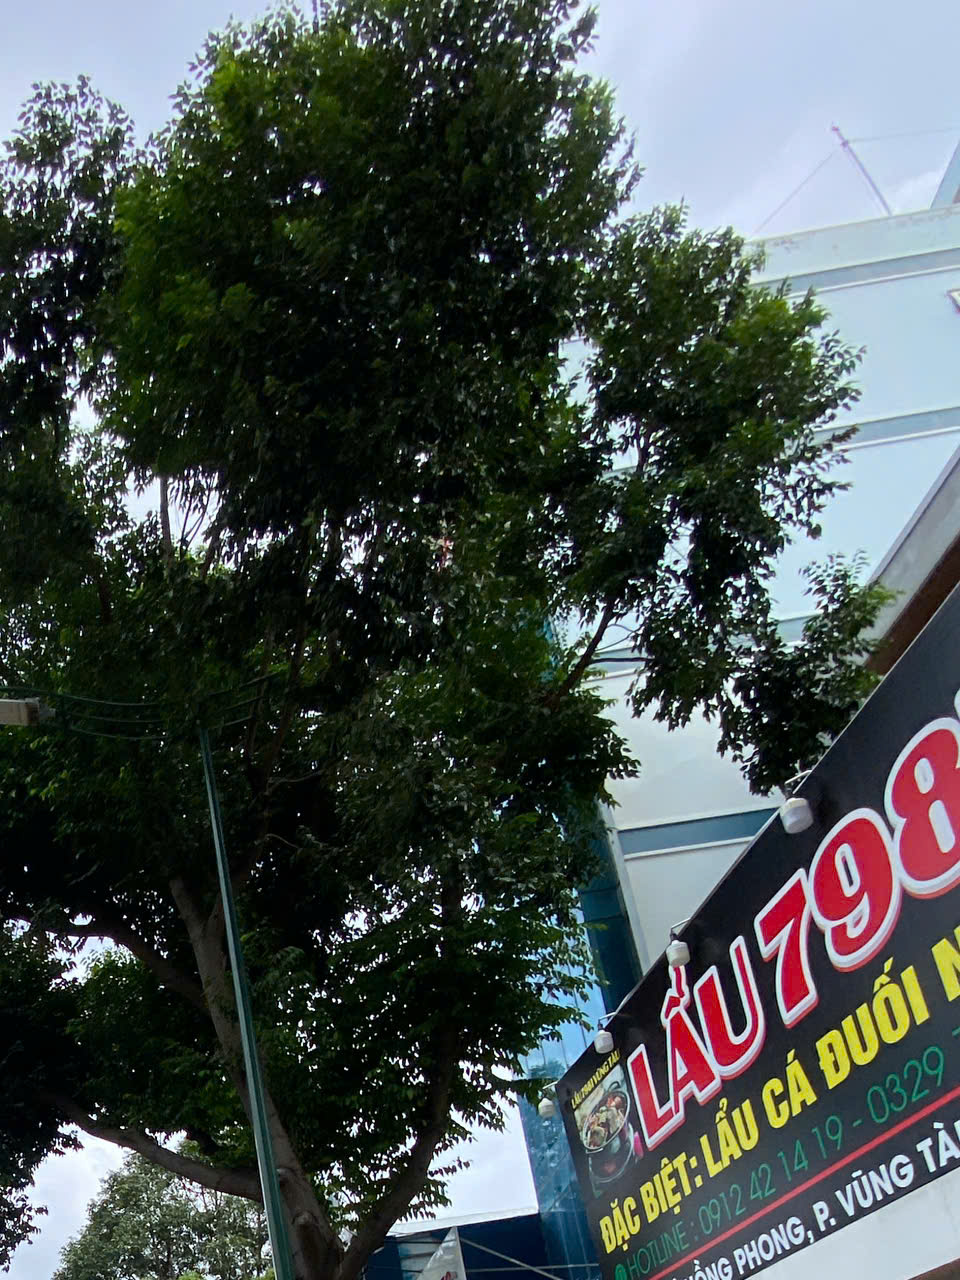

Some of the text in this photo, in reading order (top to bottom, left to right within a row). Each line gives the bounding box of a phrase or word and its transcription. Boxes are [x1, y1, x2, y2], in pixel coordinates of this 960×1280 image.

[599, 1196, 641, 1254] ĐẶC
[640, 1151, 703, 1224] BIỆT:
[699, 1097, 759, 1177] LẨU
[762, 1049, 817, 1128] CÁ
[816, 957, 930, 1089] ĐUỐI
[698, 1184, 746, 1235] 0912
[750, 1163, 776, 1201] 42
[777, 1139, 808, 1181] 14
[811, 1115, 843, 1159] 19
[867, 1046, 944, 1123] 0329
[733, 1217, 815, 1276] PHONG,
[812, 1201, 836, 1232] P.
[835, 1154, 914, 1217] VŨNG
